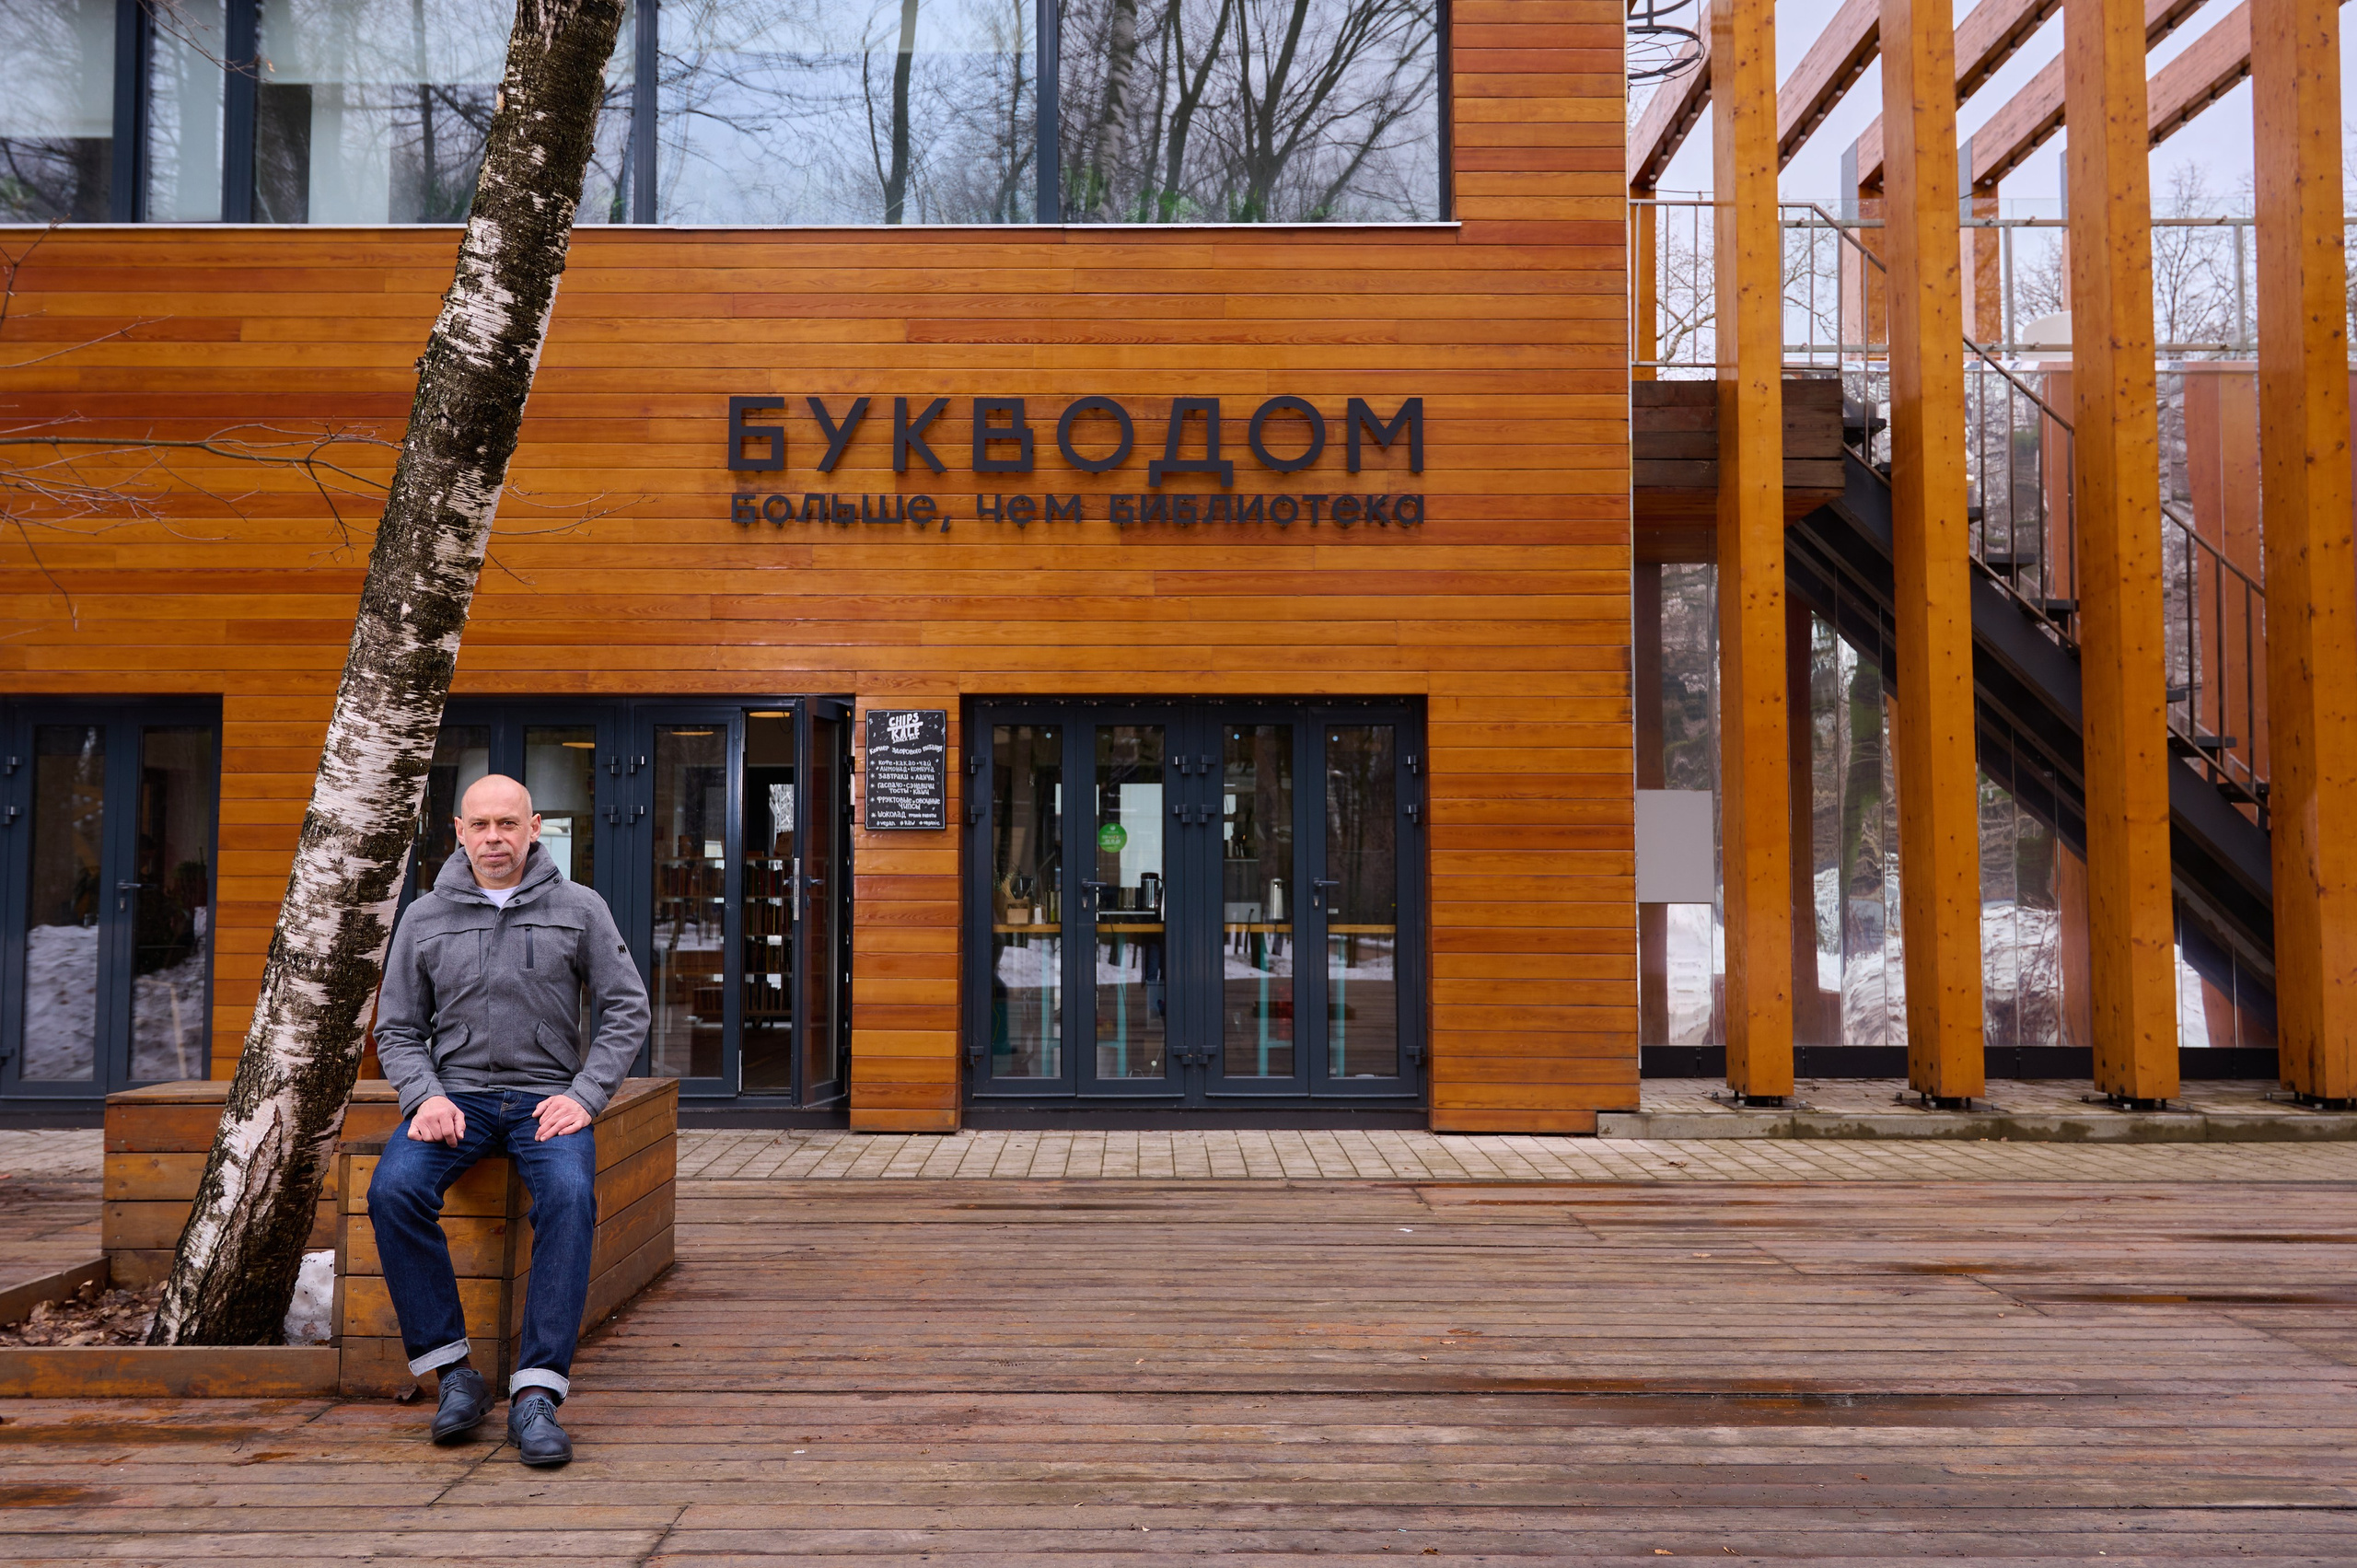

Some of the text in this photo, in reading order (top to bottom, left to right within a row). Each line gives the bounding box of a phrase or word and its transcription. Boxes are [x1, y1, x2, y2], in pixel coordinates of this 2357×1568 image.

[728, 395, 1423, 487] БУКВОДОМ
[977, 494, 1083, 524] чем
[1109, 494, 1423, 524] библиотека
[888, 712, 920, 727] CHIPS
[890, 726, 920, 739] KALE
